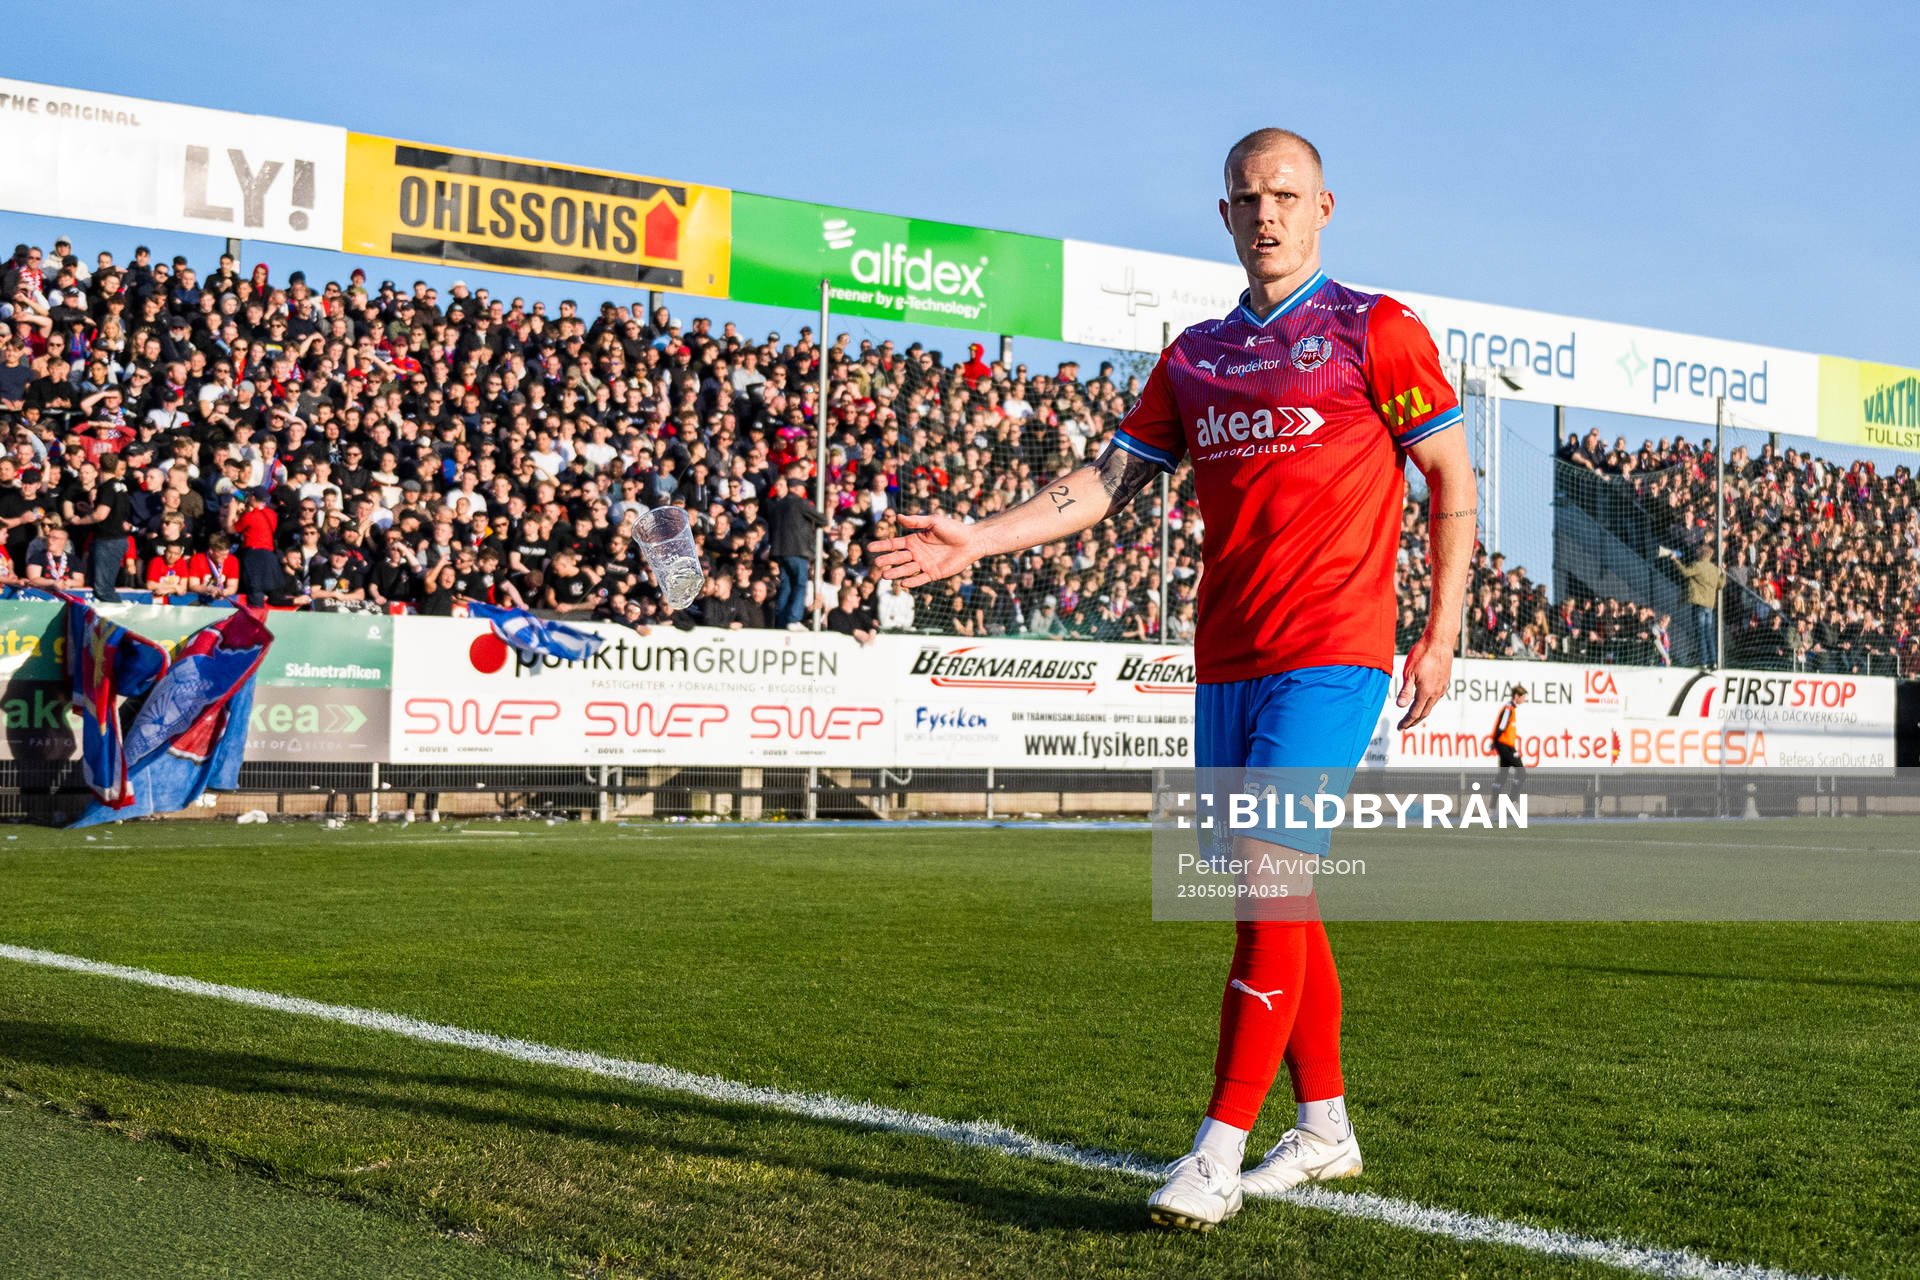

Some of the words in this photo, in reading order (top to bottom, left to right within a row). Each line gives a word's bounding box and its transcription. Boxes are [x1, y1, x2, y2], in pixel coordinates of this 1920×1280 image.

[0, 93, 39, 113] THE
[45, 100, 142, 127] ORIGINAL
[399, 175, 637, 254] OHLSSONS
[850, 242, 984, 298] alfdex
[829, 286, 874, 304] reener
[875, 289, 893, 308] by
[1226, 360, 1280, 376] kondektor
[1447, 328, 1575, 379] prenad
[1653, 357, 1767, 404] prenad
[1381, 386, 1432, 427] XXL
[1863, 376, 1920, 429] VÄXTH
[1196, 406, 1275, 447] akea
[1229, 448, 1243, 456] OF
[1257, 443, 1296, 454] ELEDA
[1048, 485, 1076, 514] 21
[0, 630, 42, 656] ta
[284, 662, 382, 680] Skånetrafiken
[910, 646, 1098, 681] BERGKVARABUSS
[1584, 670, 1618, 695] ICA
[4, 690, 84, 729] ake
[248, 703, 320, 734] kea
[404, 698, 561, 736] SWEP
[584, 701, 729, 738] SWEP
[750, 705, 884, 740] SWEP
[915, 706, 988, 733] Fysiken
[245, 739, 266, 749] ART
[1024, 731, 1188, 759] www.fysiken.se
[1630, 728, 1768, 766] BEFESA
[1779, 752, 1814, 767] Befesa
[1816, 752, 1867, 767] ScanDust
[1868, 752, 1884, 767] AB
